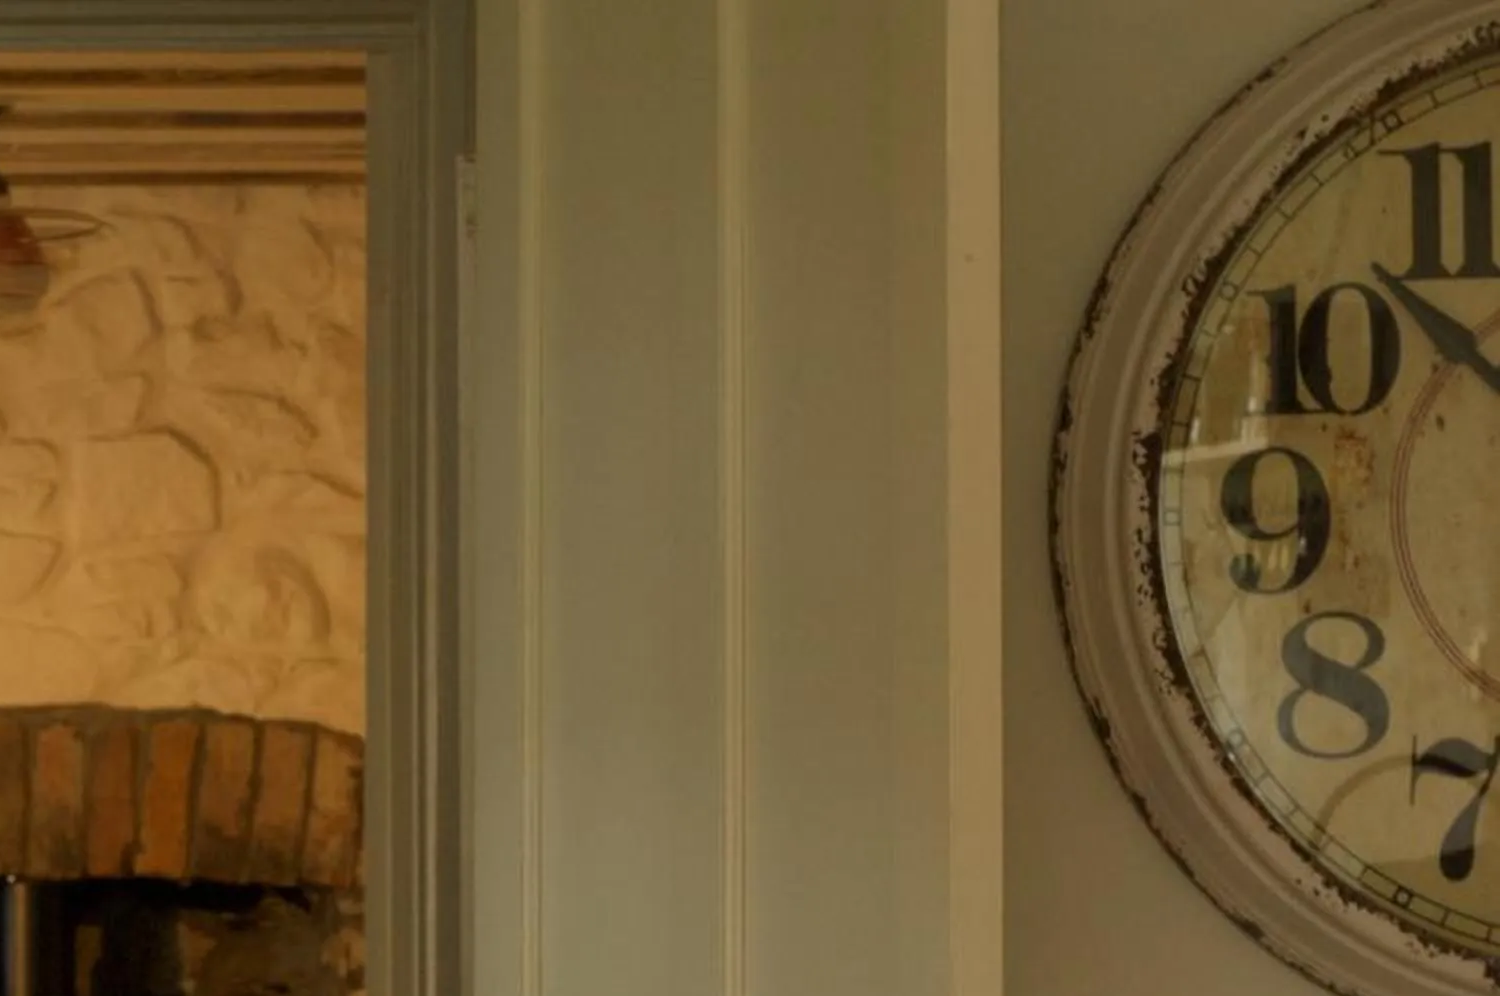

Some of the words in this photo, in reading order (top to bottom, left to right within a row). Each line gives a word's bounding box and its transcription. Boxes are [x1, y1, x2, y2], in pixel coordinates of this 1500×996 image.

[1377, 140, 1500, 281] 11
[1246, 282, 1401, 415] 10
[1220, 447, 1331, 594] 9
[1277, 611, 1390, 759] 8
[1409, 735, 1500, 882] 7
